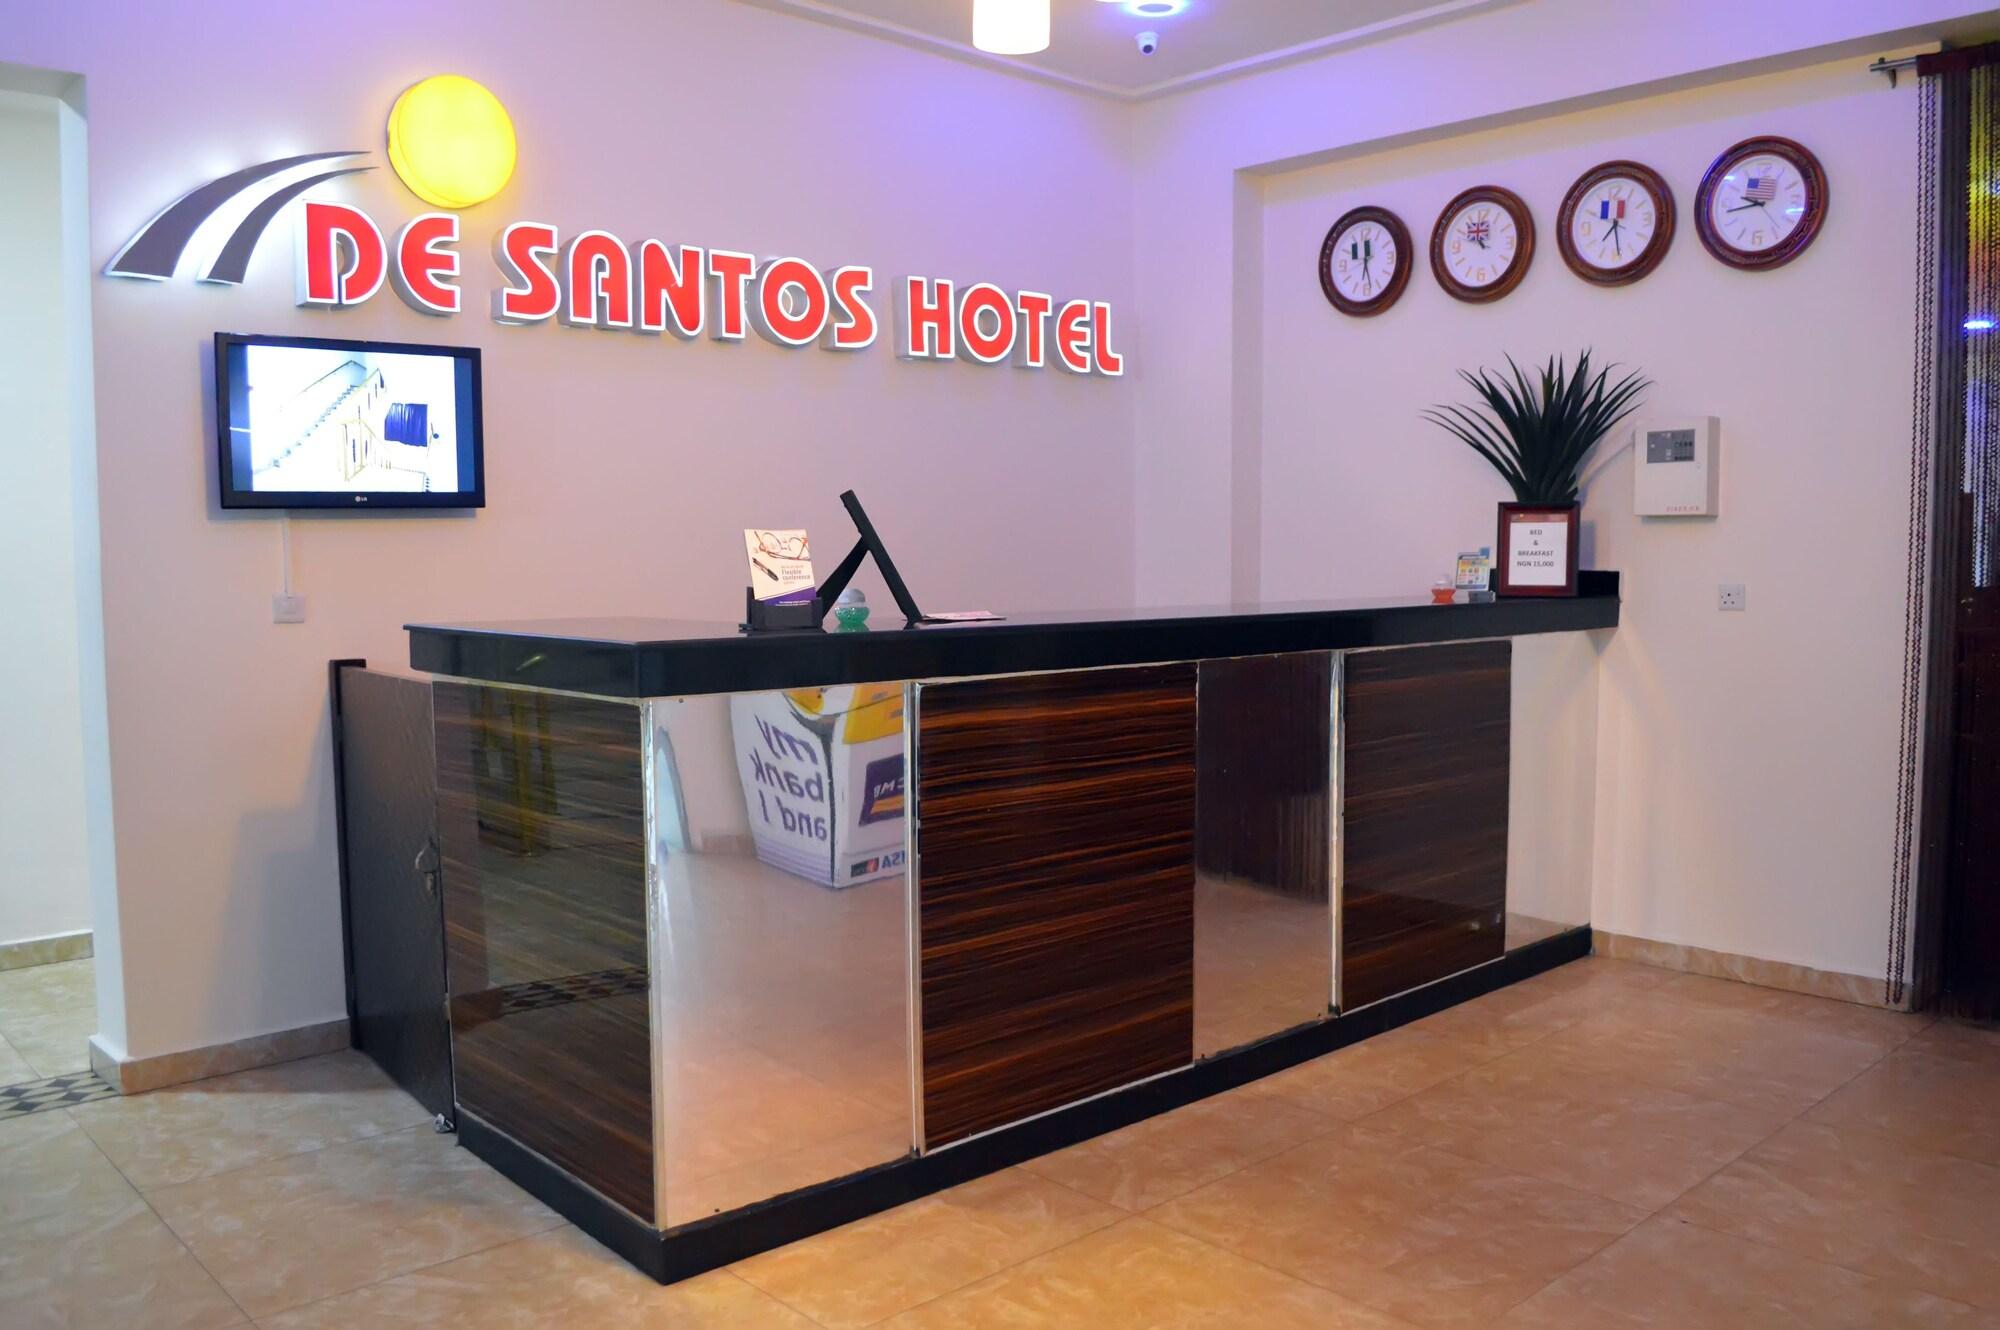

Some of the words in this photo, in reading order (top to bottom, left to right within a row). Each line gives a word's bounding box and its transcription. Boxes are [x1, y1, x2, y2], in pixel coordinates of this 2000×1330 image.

[300, 198, 461, 314] DE
[497, 221, 878, 350] SANTOS
[902, 275, 1124, 377] HOTEL
